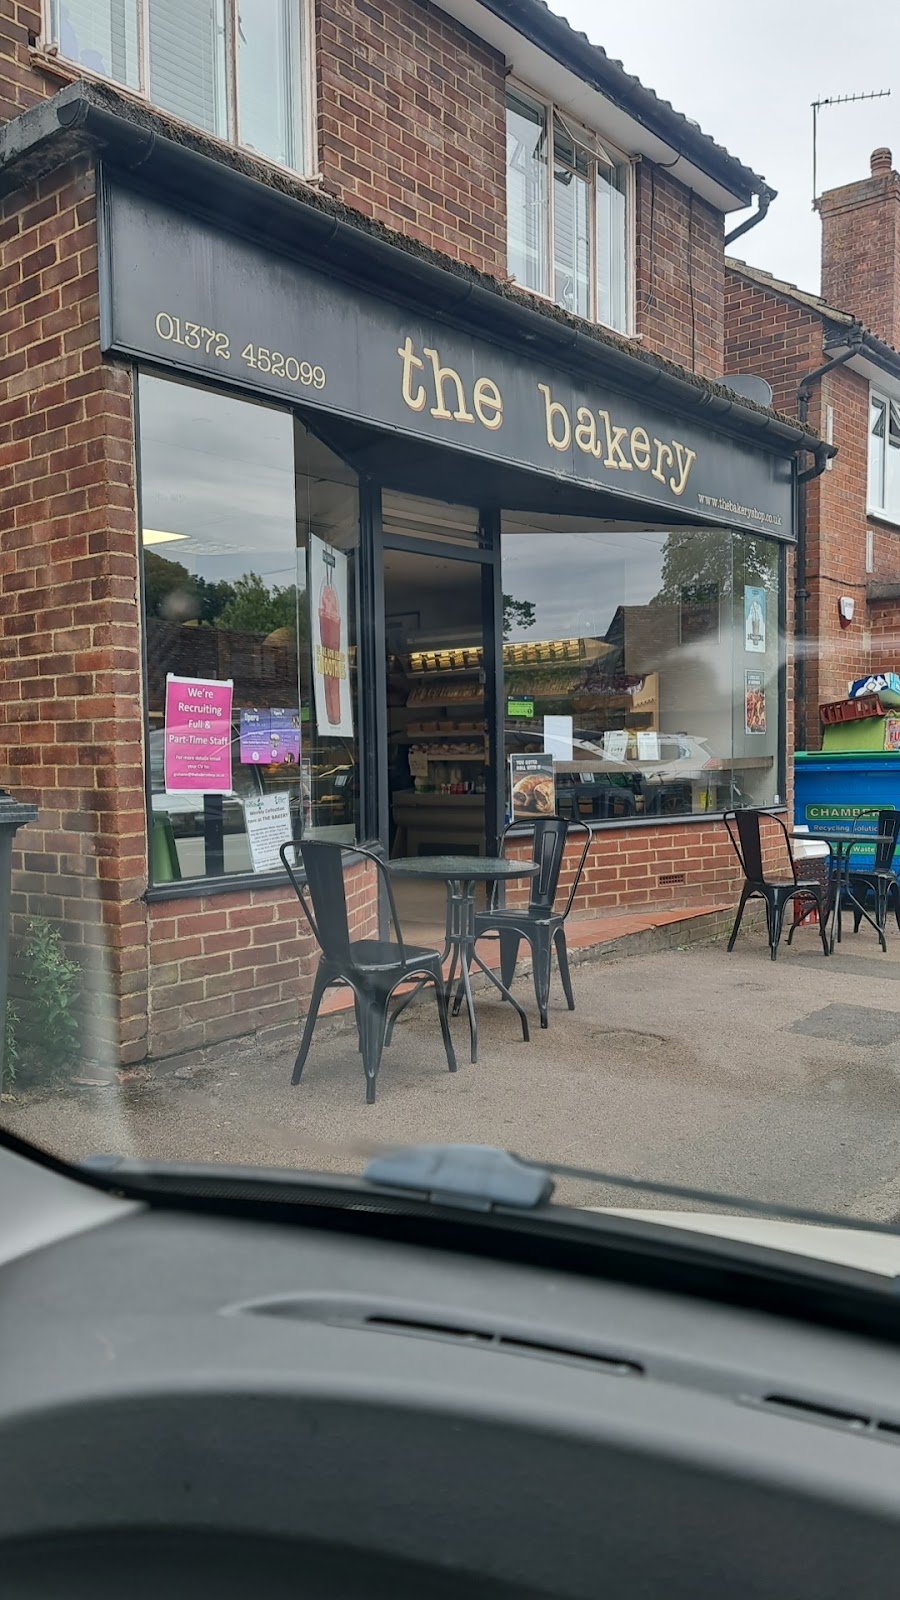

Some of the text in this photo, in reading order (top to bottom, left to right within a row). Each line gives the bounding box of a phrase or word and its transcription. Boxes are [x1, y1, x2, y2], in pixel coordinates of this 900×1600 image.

[155, 311, 327, 390] 01372 452099
[396, 335, 697, 497] the bakery
[697, 492, 782, 525] www.thebakeryshop.co.uk
[187, 687, 214, 699] We're
[178, 702, 222, 716] Recruiting
[188, 719, 211, 729] Full &
[169, 734, 208, 746] Part-Time
[209, 735, 229, 746] Staff
[810, 808, 884, 817] CHAMBER
[813, 824, 849, 832] Recycling
